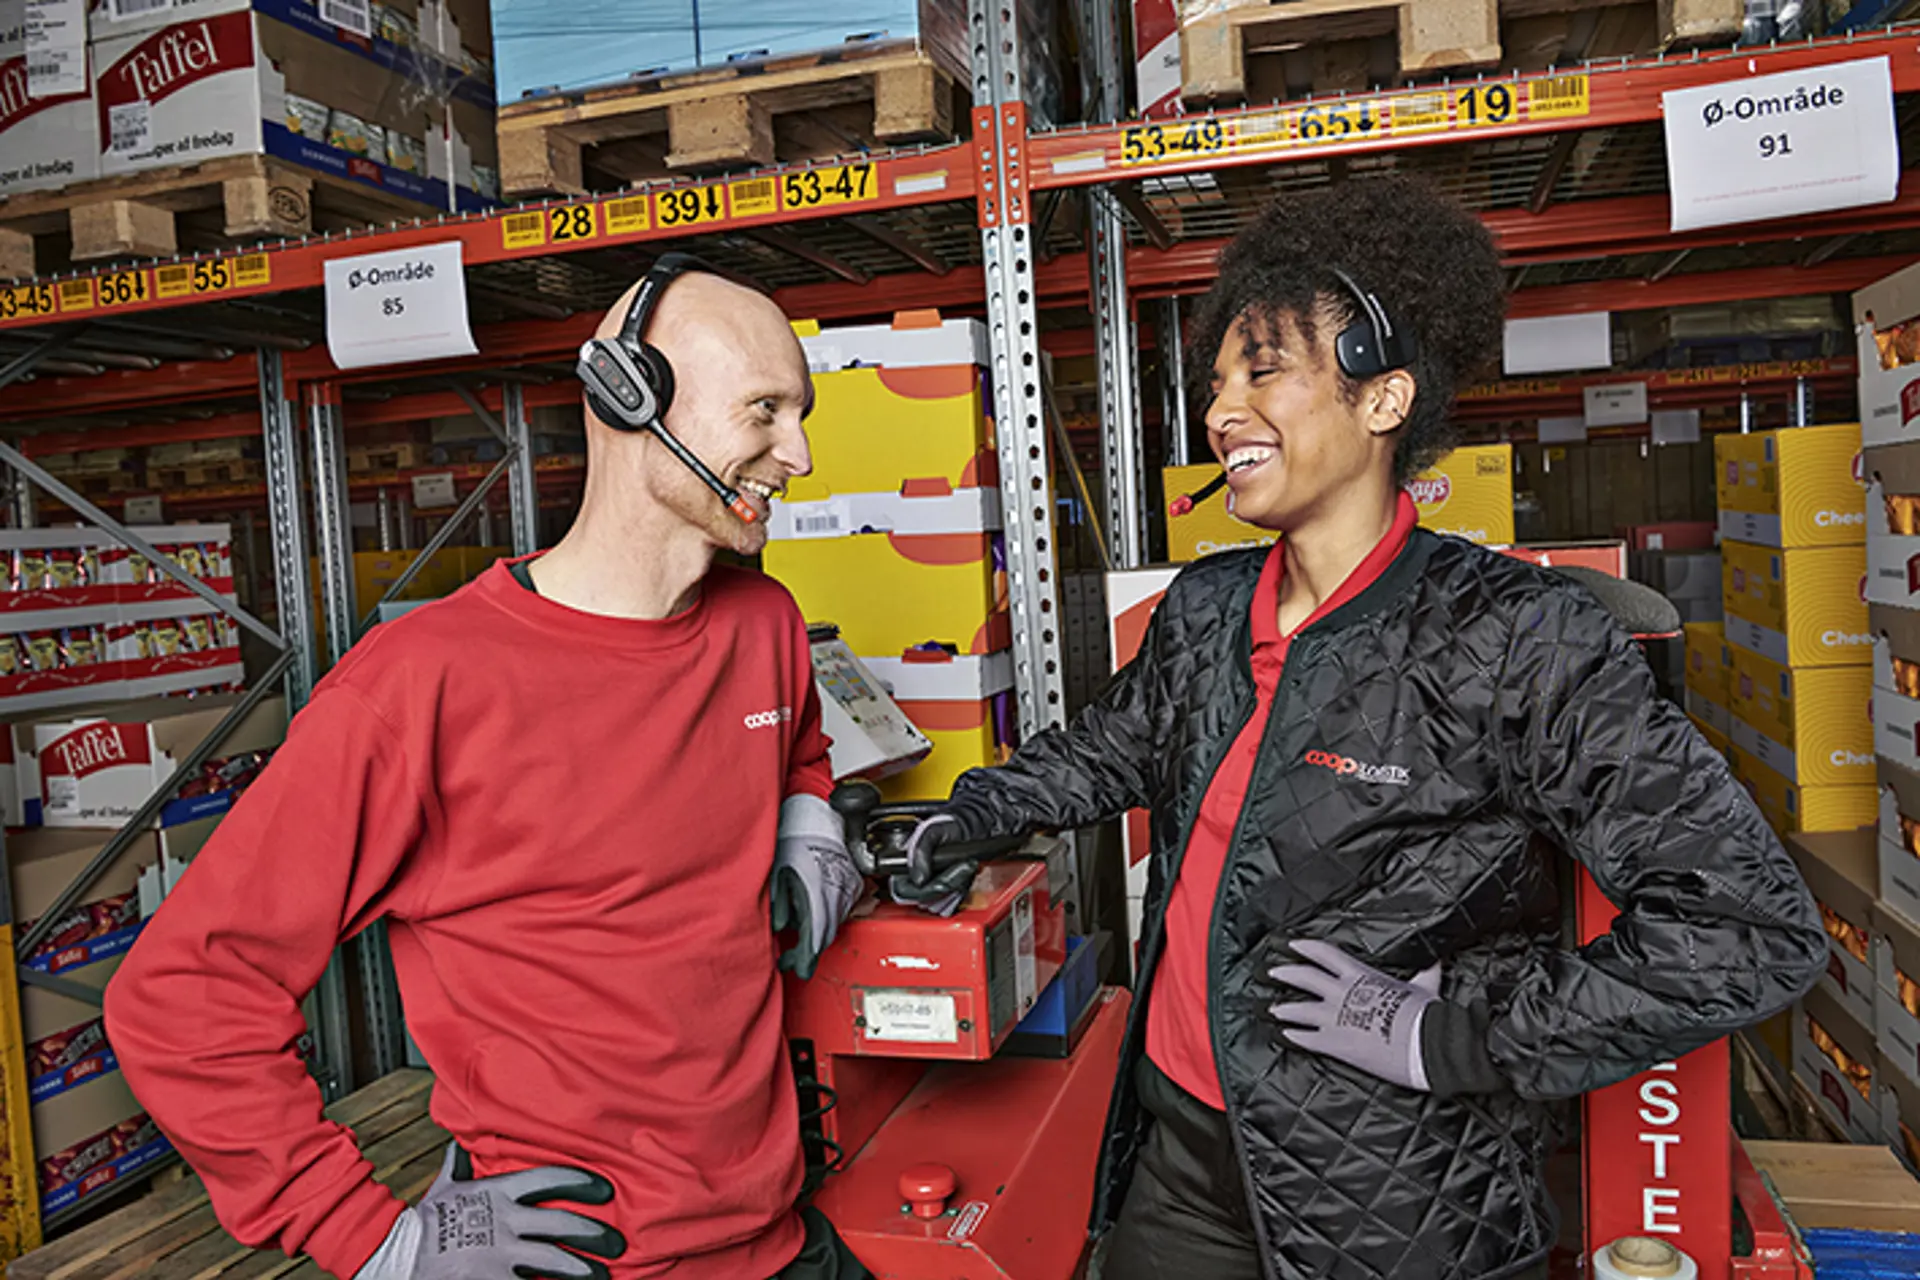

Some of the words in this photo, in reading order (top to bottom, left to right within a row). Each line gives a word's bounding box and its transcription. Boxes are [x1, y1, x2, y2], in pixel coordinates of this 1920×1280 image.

[119, 23, 220, 101] Taffel
[1124, 120, 1224, 163] 53-49
[1300, 106, 1338, 144] 65
[1457, 85, 1512, 125] 19
[1702, 85, 1844, 127] Ø-Område
[1759, 134, 1793, 158] 91
[551, 204, 591, 240] 28
[660, 190, 699, 224] 39
[785, 165, 871, 208] 53-47
[100, 272, 131, 305] 56
[194, 262, 228, 291] 55
[349, 260, 434, 289] Ø-Område
[381, 297, 404, 316] 85
[54, 724, 127, 775] Taffel
[1305, 750, 1359, 776] coop
[1638, 1063, 1681, 1233] STE
